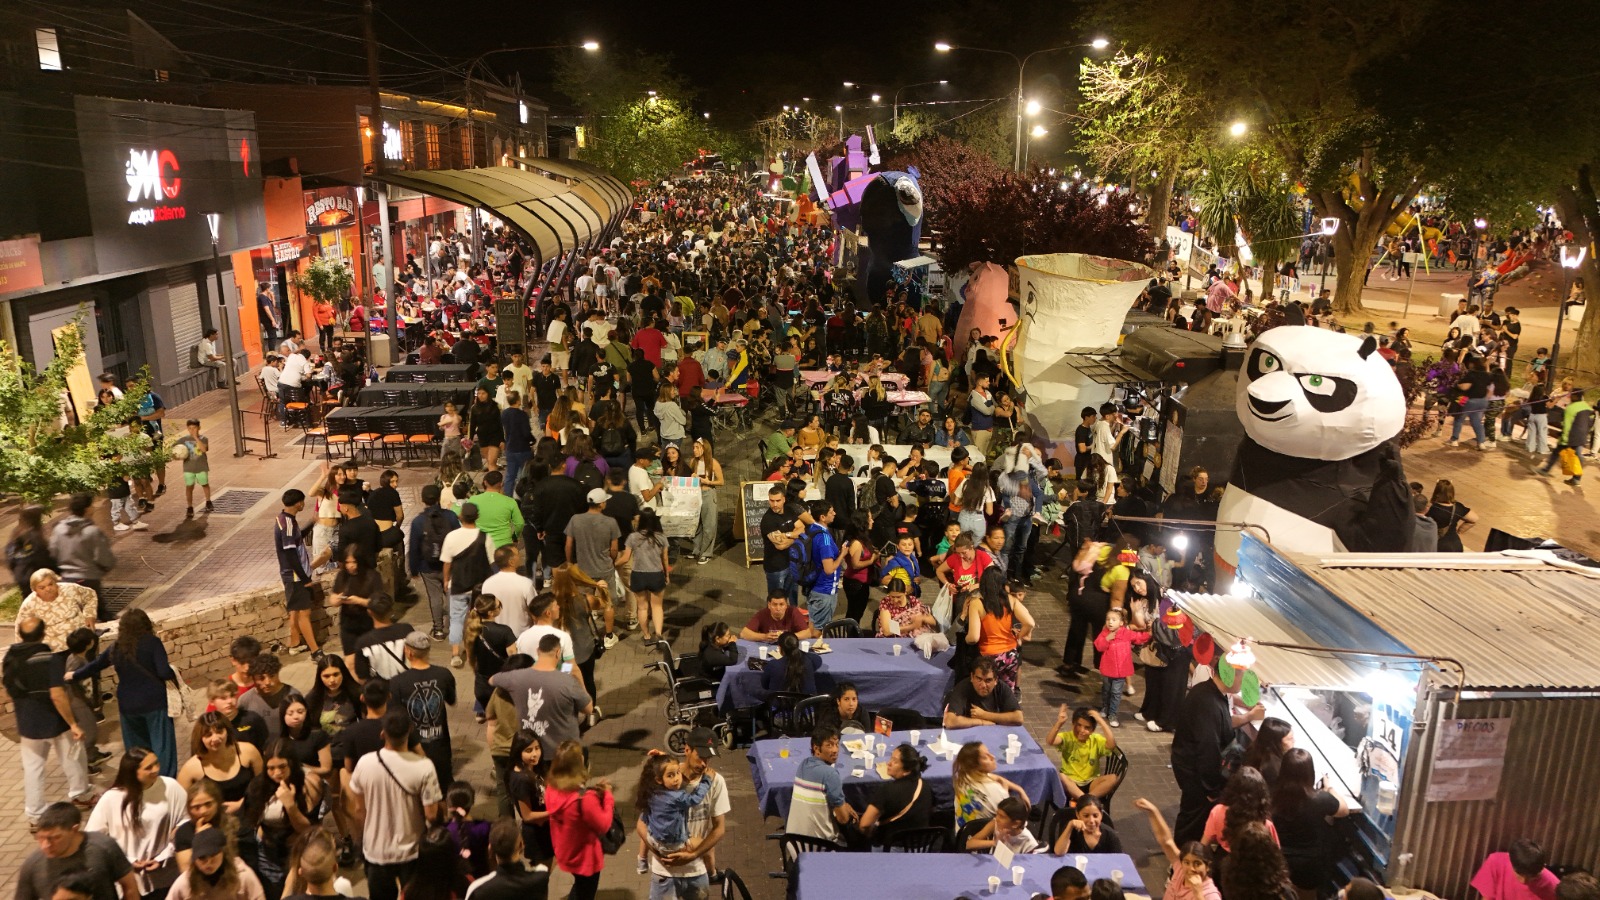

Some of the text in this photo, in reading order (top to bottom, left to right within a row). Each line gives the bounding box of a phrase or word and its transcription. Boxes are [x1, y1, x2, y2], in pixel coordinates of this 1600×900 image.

[306, 196, 354, 225] RESTO BAR
[1380, 718, 1397, 752] 14
